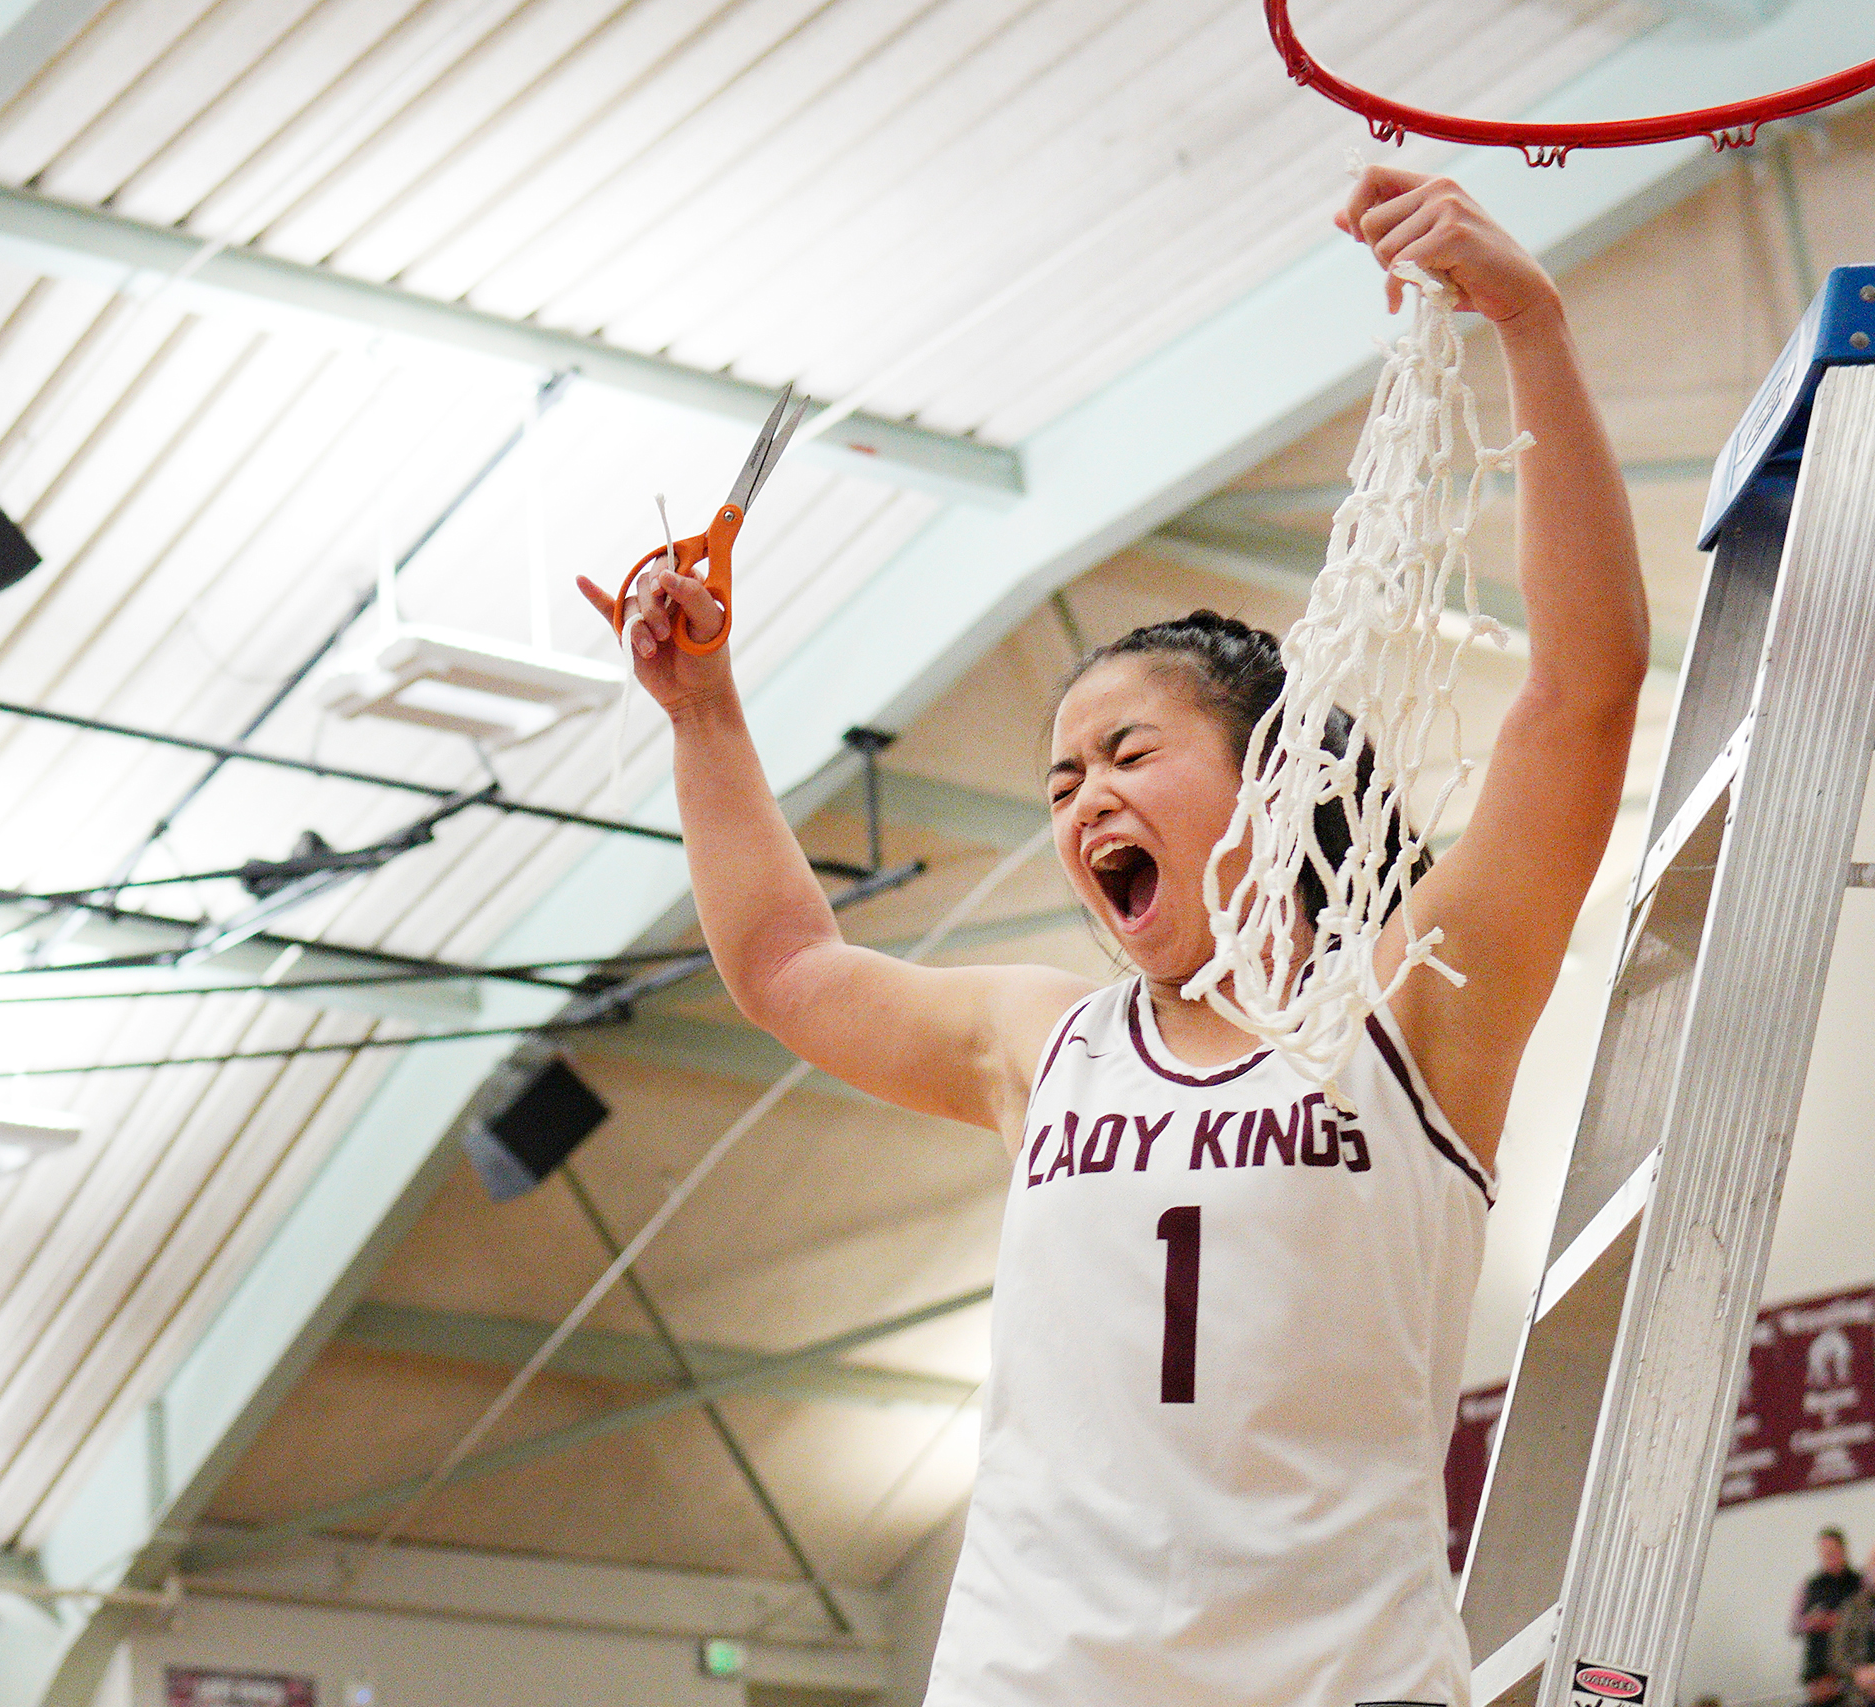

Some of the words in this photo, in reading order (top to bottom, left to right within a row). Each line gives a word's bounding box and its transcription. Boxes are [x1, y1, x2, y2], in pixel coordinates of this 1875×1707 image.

[1026, 1110, 1176, 1190] LADY
[1188, 1092, 1372, 1173] KINGS
[1156, 1205, 1201, 1404] 1
[1582, 1673, 1635, 1692] DANGER
